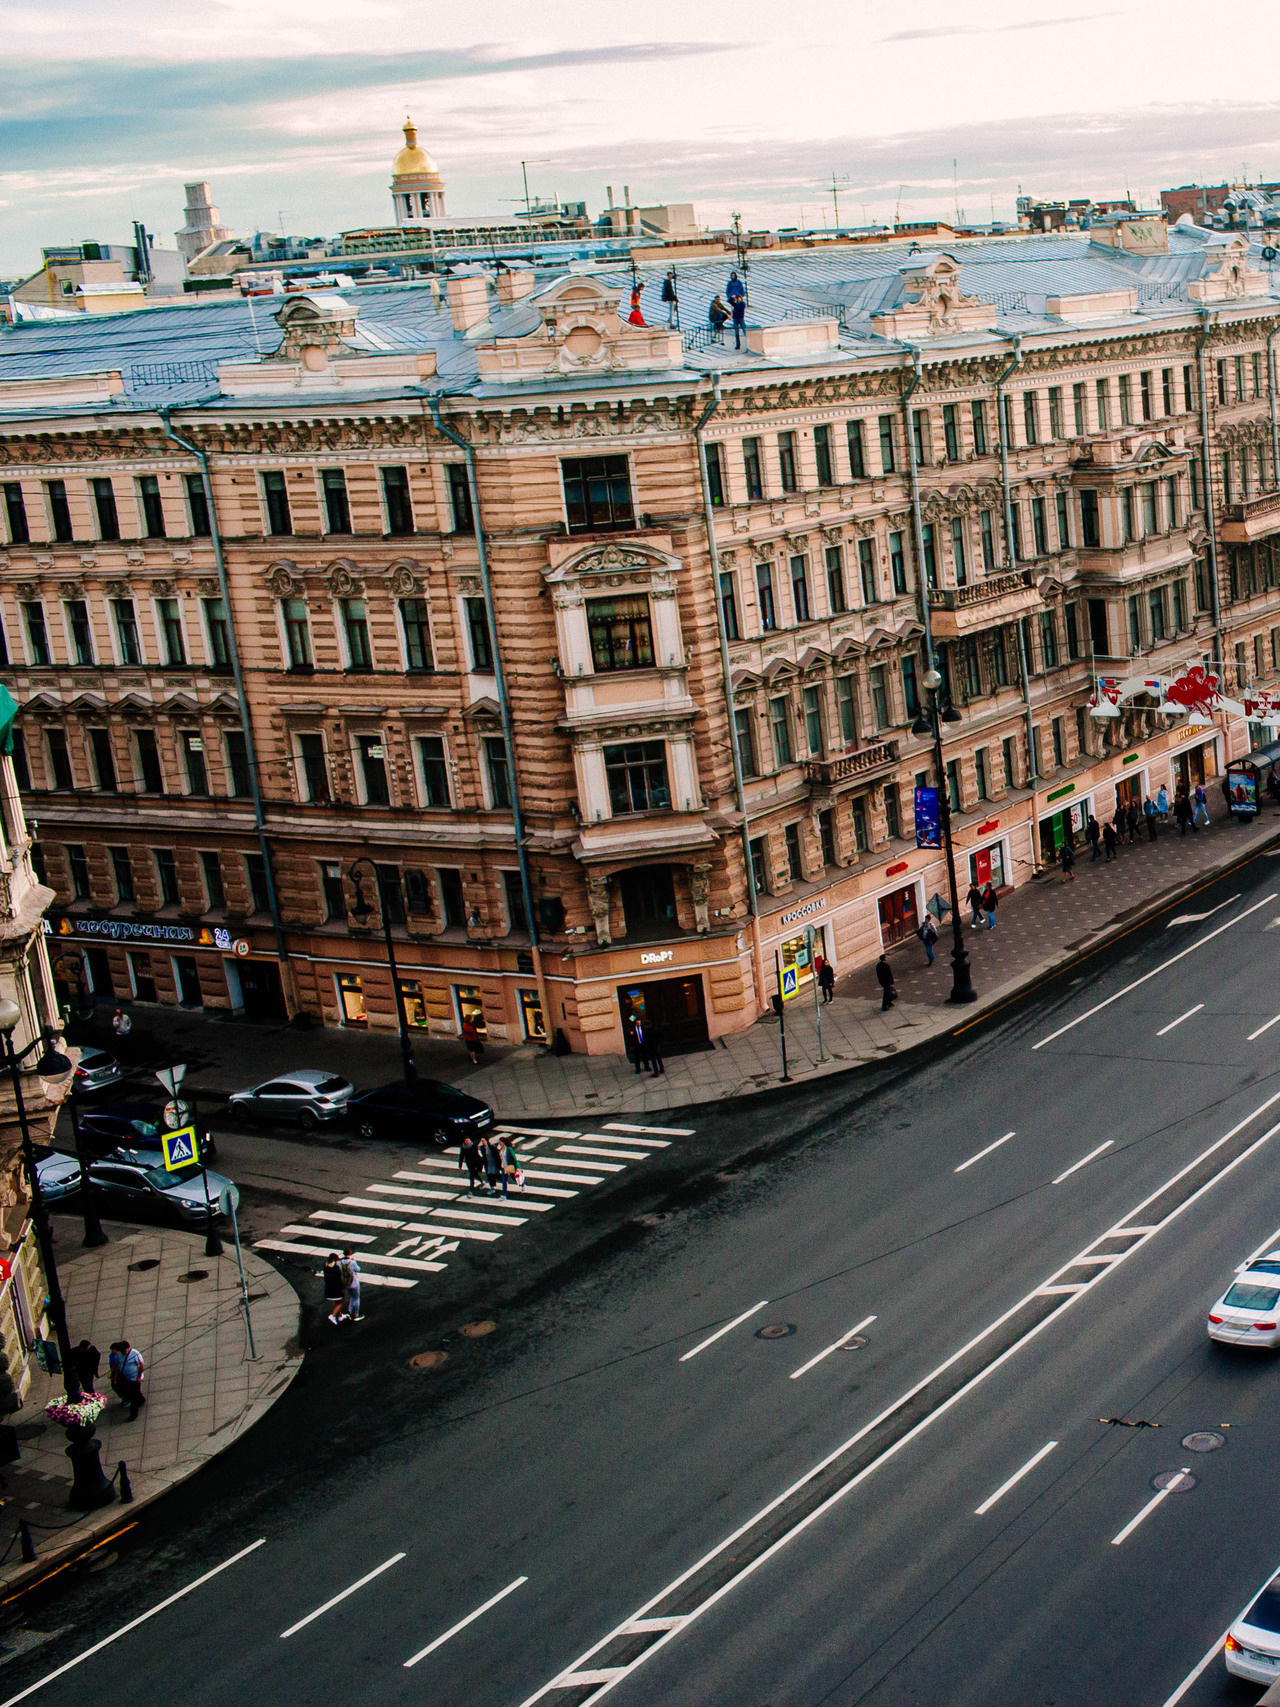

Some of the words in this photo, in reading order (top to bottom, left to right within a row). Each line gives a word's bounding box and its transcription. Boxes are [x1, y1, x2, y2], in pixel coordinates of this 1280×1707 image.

[782, 898, 826, 925] КРОССОВКИ
[76, 918, 194, 940] чебуречная
[214, 928, 230, 942] 24
